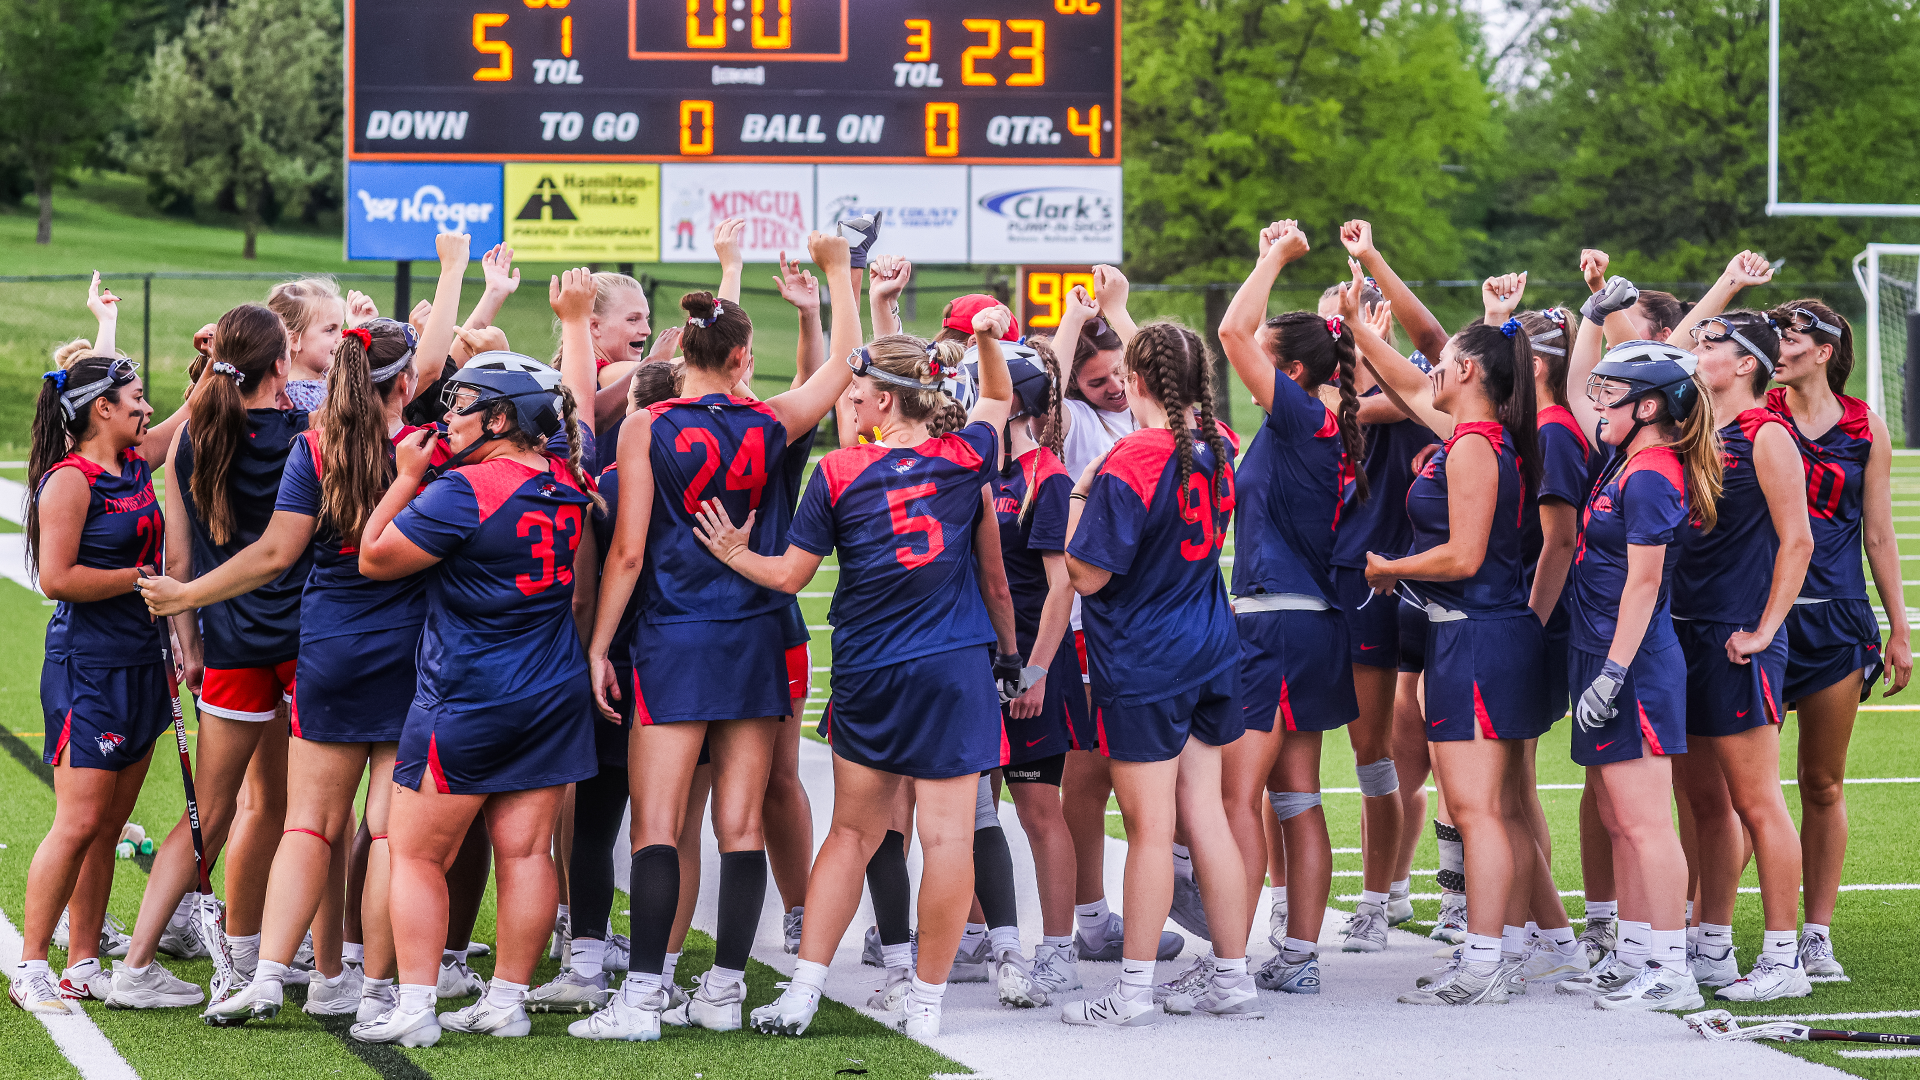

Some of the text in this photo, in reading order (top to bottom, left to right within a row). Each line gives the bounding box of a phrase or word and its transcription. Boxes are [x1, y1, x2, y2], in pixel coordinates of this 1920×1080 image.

[473, 14, 513, 81] 5
[561, 16, 572, 57] 1
[904, 19, 931, 61] 3
[961, 19, 1045, 86] 23
[533, 60, 583, 84] TOL
[893, 63, 943, 87] TOL
[366, 111, 469, 140] DOWN
[540, 112, 640, 142] TO GO
[680, 100, 714, 155] 0
[741, 114, 885, 144] BALL ON
[925, 102, 959, 157] 0
[986, 116, 1061, 146] QTR.
[1067, 105, 1101, 157] 4
[401, 184, 494, 234] Kroger
[708, 190, 805, 230] MINGUA
[1014, 195, 1112, 219] Clark's
[674, 426, 769, 515] 24
[886, 482, 946, 571] 5
[1176, 461, 1236, 562] 99
[515, 504, 582, 597] 33
[171, 696, 189, 754] CUMBERLANDS
[187, 800, 200, 829] GAIT
[1879, 1034, 1911, 1044] GAIT
